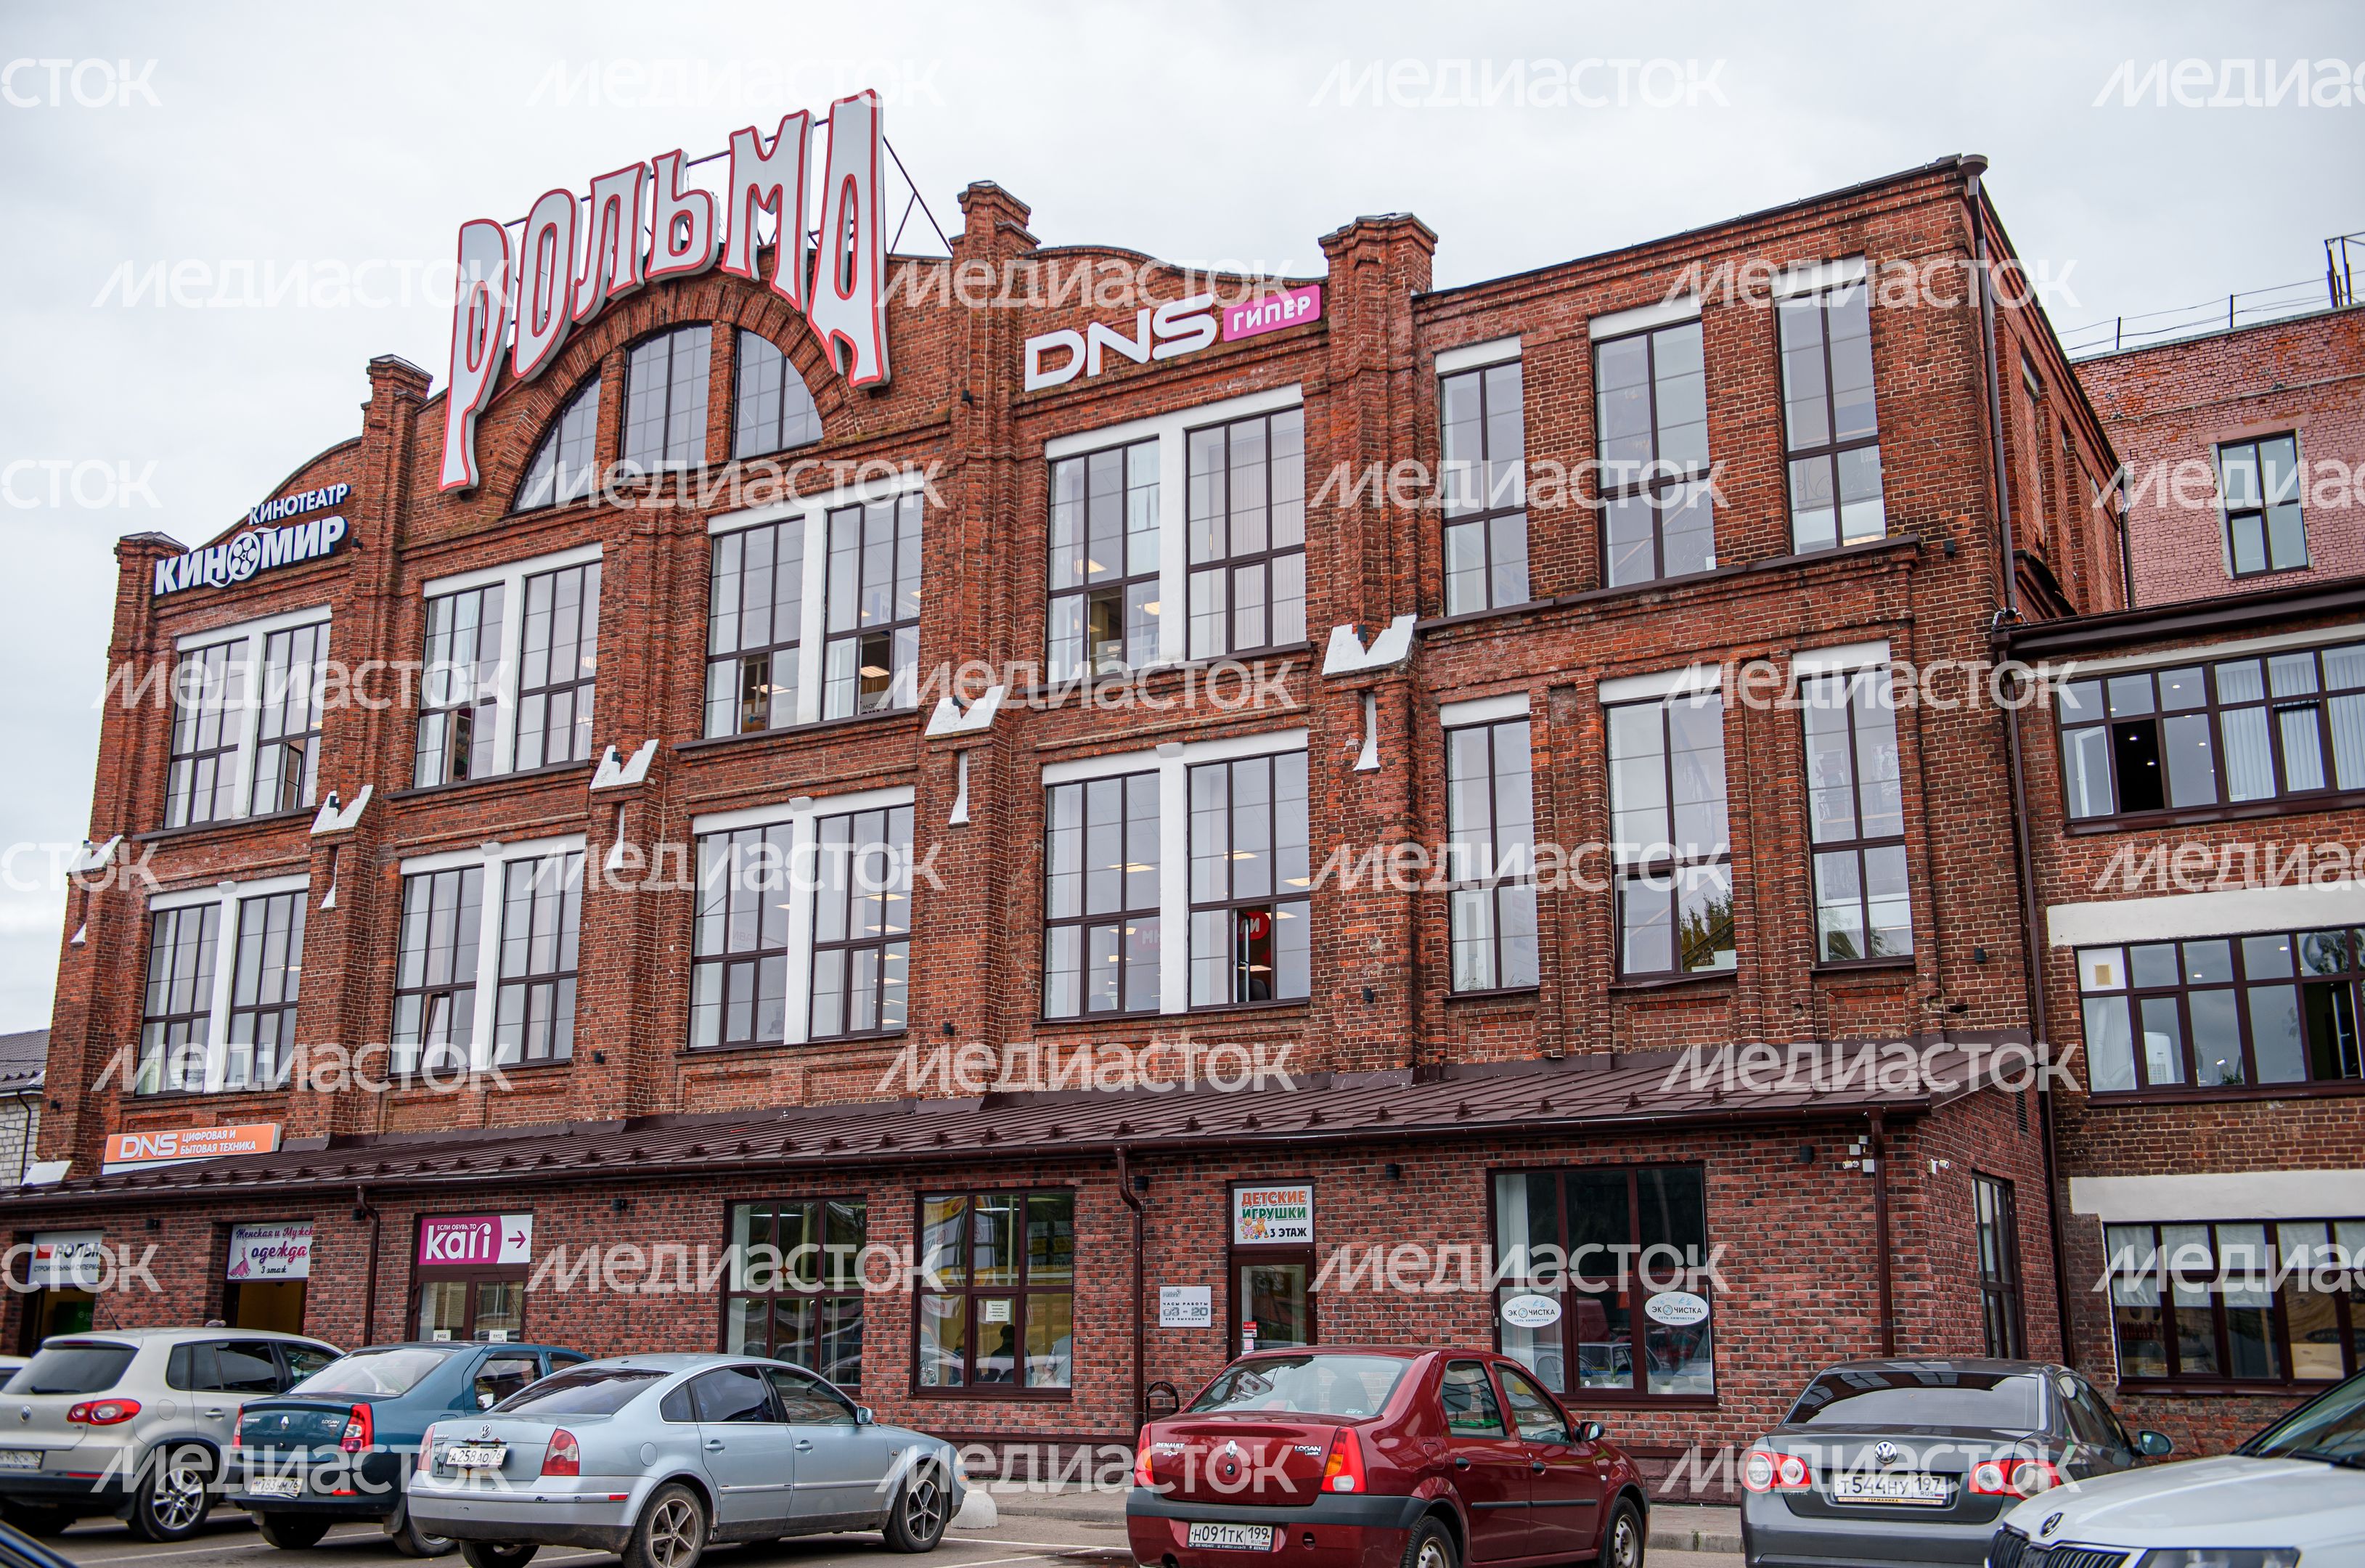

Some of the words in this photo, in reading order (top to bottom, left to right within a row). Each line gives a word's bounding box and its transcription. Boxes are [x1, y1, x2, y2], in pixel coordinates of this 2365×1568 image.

[438, 89, 891, 494] РОЛЬМА
[1232, 295, 1312, 332] ГИПЕР
[1024, 293, 1220, 393] DNS
[248, 483, 350, 526] КИНОТЕАТР
[155, 515, 348, 596] КИНОМИР
[181, 1130, 227, 1143] ЦИФРОВАЯ
[229, 1129, 236, 1139] И
[119, 1133, 178, 1159] DNS
[180, 1142, 218, 1155] БЫТОВАЯ
[219, 1140, 256, 1153] ТЕХНИКА
[1241, 1191, 1307, 1207] ДЕТСКИЕ
[1242, 1207, 1307, 1220] ИГРУШКИ
[236, 1228, 273, 1240] Женская
[425, 1223, 491, 1259] kari
[1270, 1228, 1275, 1238] 3
[1278, 1228, 1307, 1238] ЭТАЖ
[251, 1241, 308, 1264] одежда
[261, 1265, 265, 1274] 3
[266, 1265, 287, 1274] этаж
[1914, 1477, 1941, 1492] 197
[1248, 1527, 1268, 1540] 199
